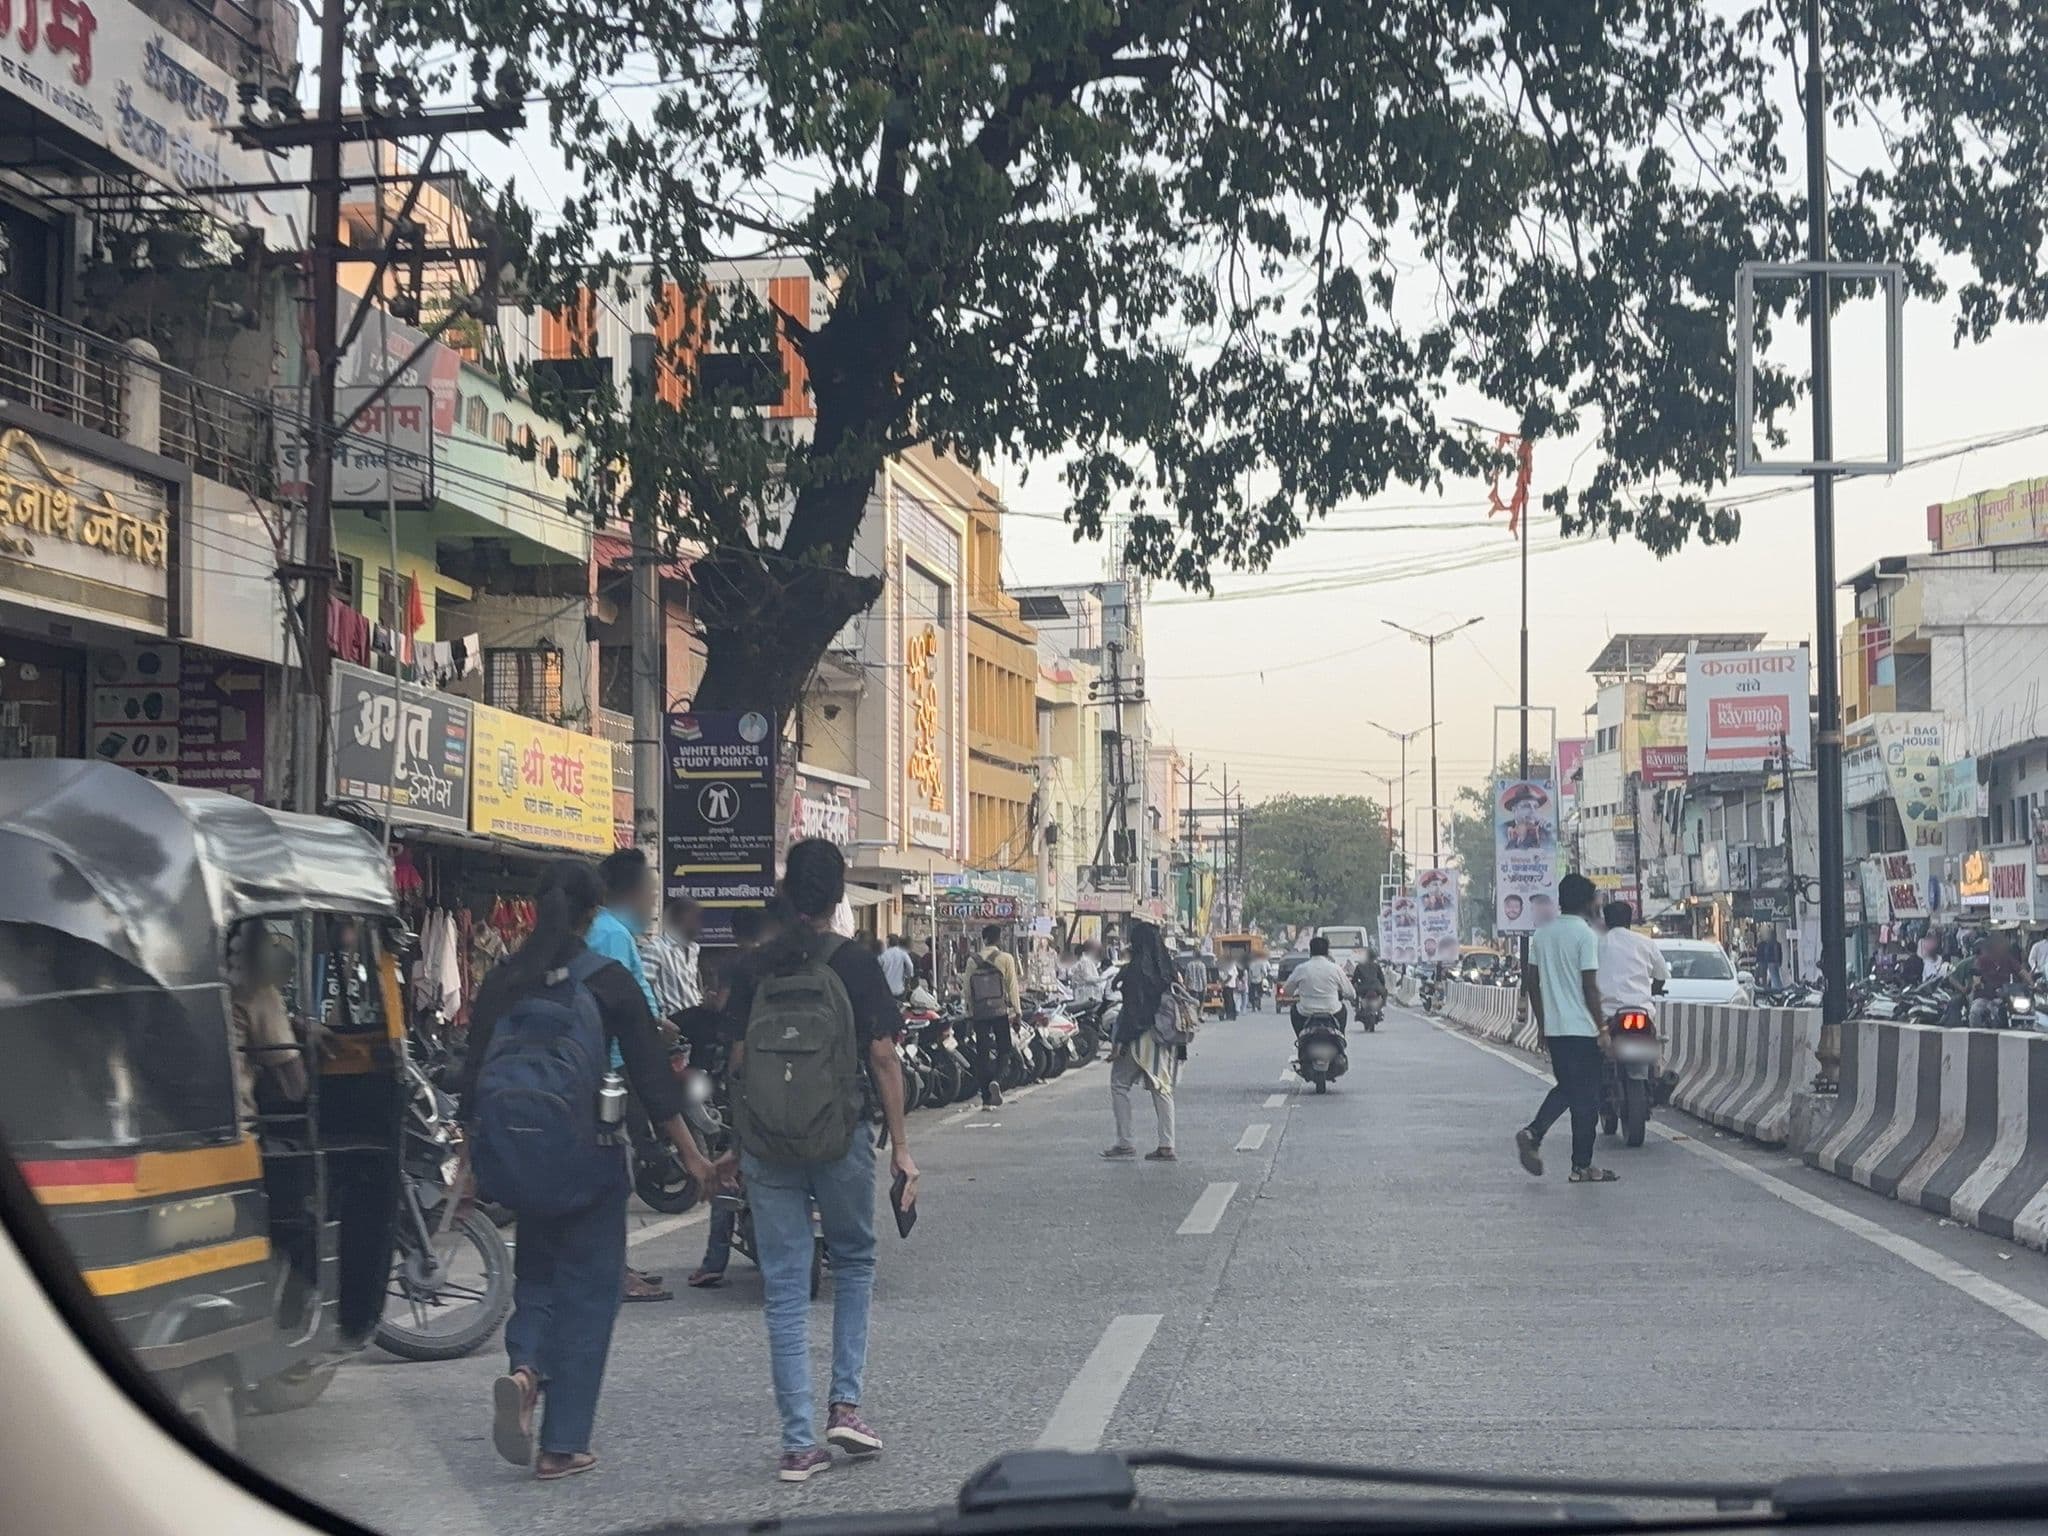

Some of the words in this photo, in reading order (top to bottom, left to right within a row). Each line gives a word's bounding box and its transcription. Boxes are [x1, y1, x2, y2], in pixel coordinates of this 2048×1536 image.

[1755, 722, 1783, 732] SHOP
[1913, 725, 1938, 736] BAG
[1902, 736, 1941, 747] HOUSE
[679, 745, 717, 757] WHITE
[720, 745, 760, 756] HOUSE
[673, 756, 713, 768] STUDY
[755, 757, 769, 767] 01
[1646, 753, 1687, 768] Raymon
